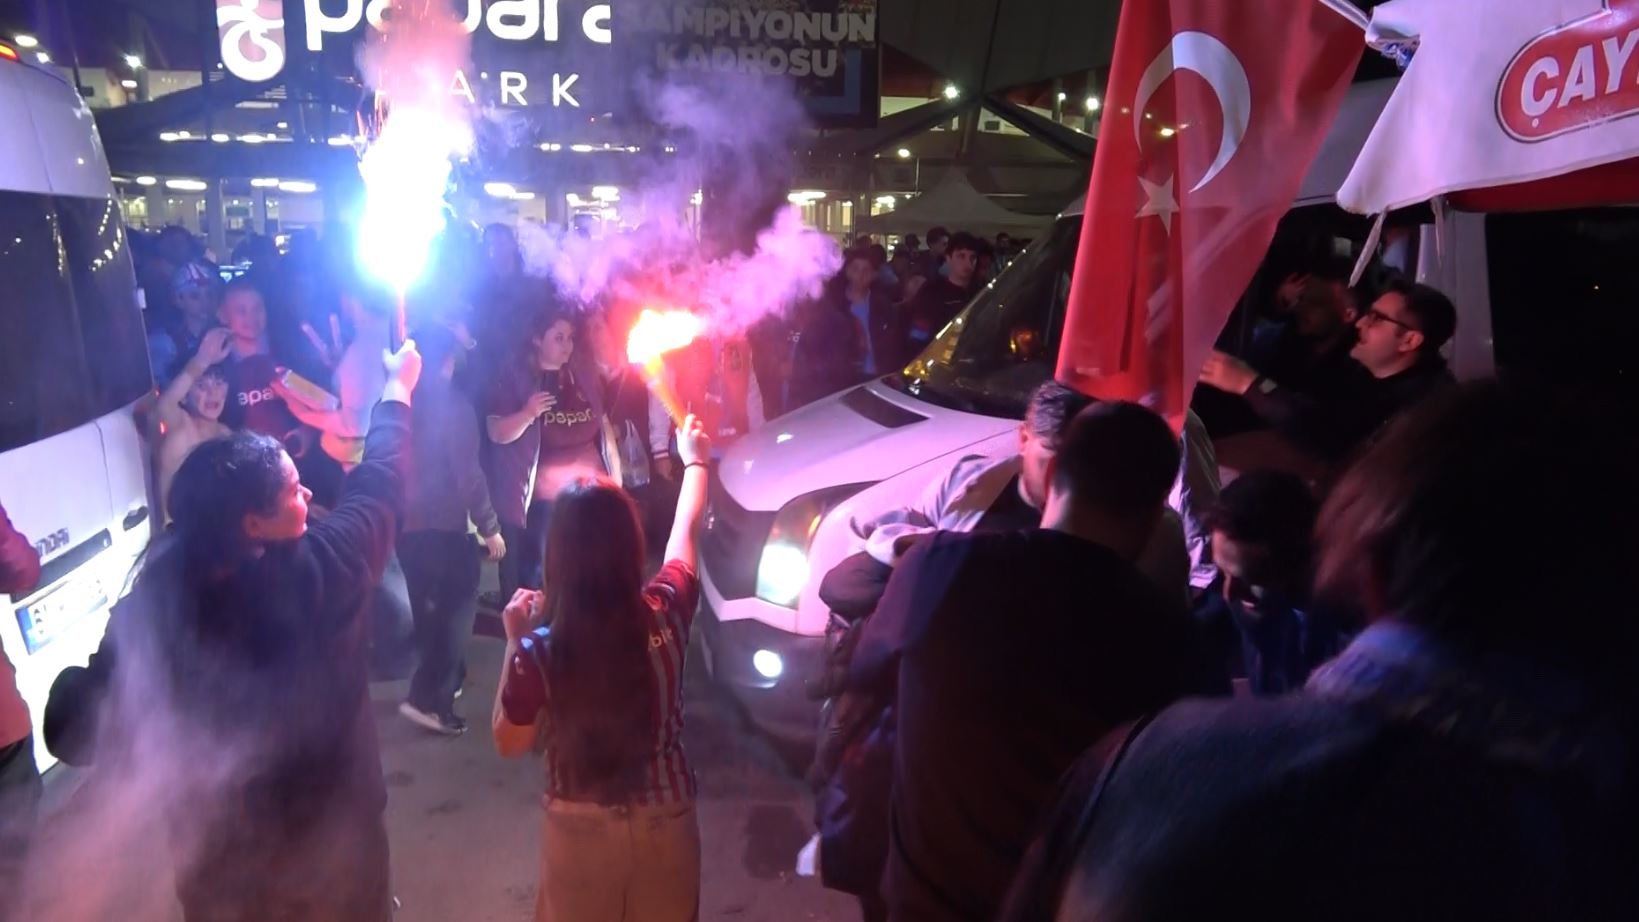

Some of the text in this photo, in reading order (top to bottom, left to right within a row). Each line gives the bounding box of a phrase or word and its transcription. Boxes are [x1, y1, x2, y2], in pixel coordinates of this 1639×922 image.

[656, 42, 838, 77] KADROSU
[1520, 28, 1639, 128] ÇAY
[543, 408, 592, 427] papar
